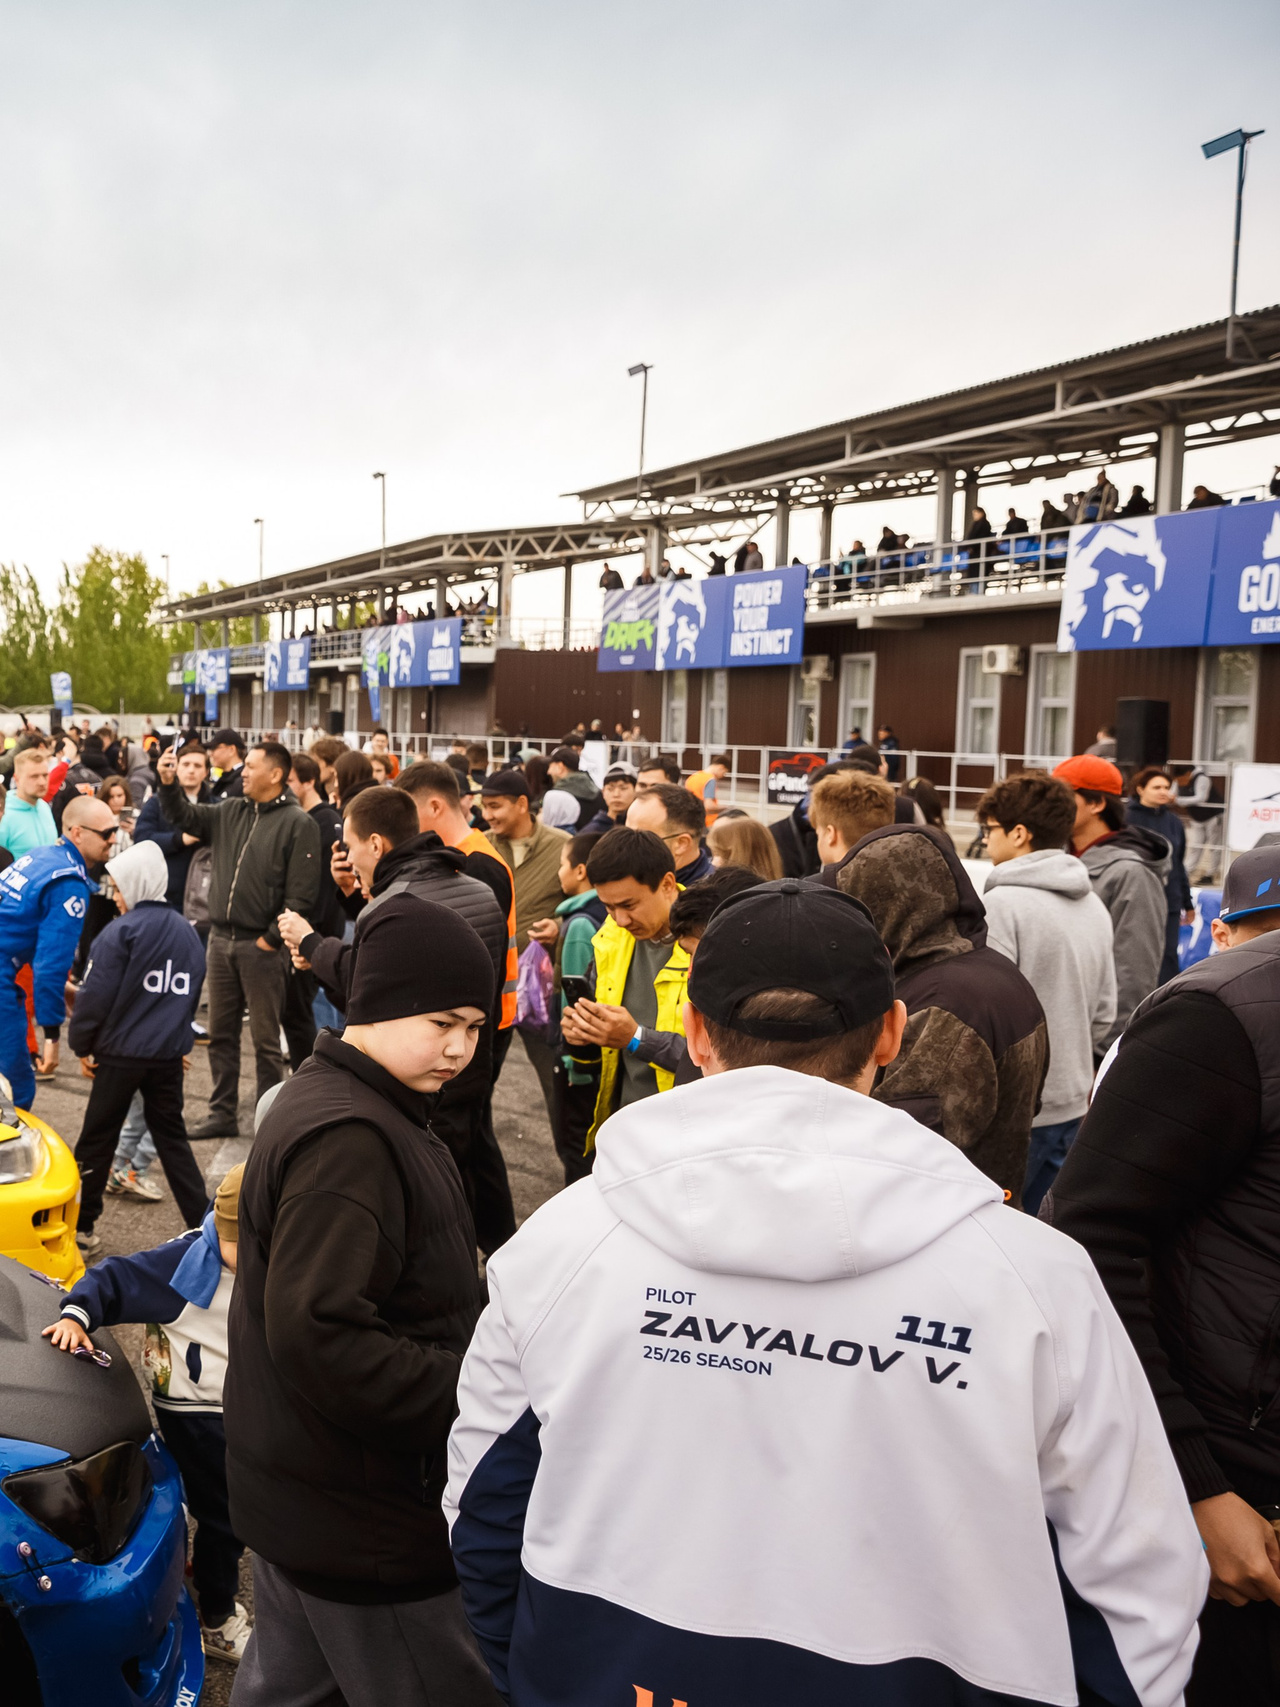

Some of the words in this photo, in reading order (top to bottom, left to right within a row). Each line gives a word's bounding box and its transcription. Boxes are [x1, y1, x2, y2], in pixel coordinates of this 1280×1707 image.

[733, 579, 784, 607] POWER
[1238, 563, 1280, 613] GO
[733, 606, 770, 632] YOUR
[730, 628, 794, 657] INSTINCT
[143, 959, 190, 995] ala
[646, 1287, 697, 1306] PILOT
[895, 1314, 972, 1354] 111
[640, 1310, 905, 1373] ZAVYALOV
[925, 1356, 969, 1390] V.
[643, 1345, 691, 1364] 25/26
[696, 1352, 772, 1376] SEASON
[174, 1686, 196, 1707] OLY
